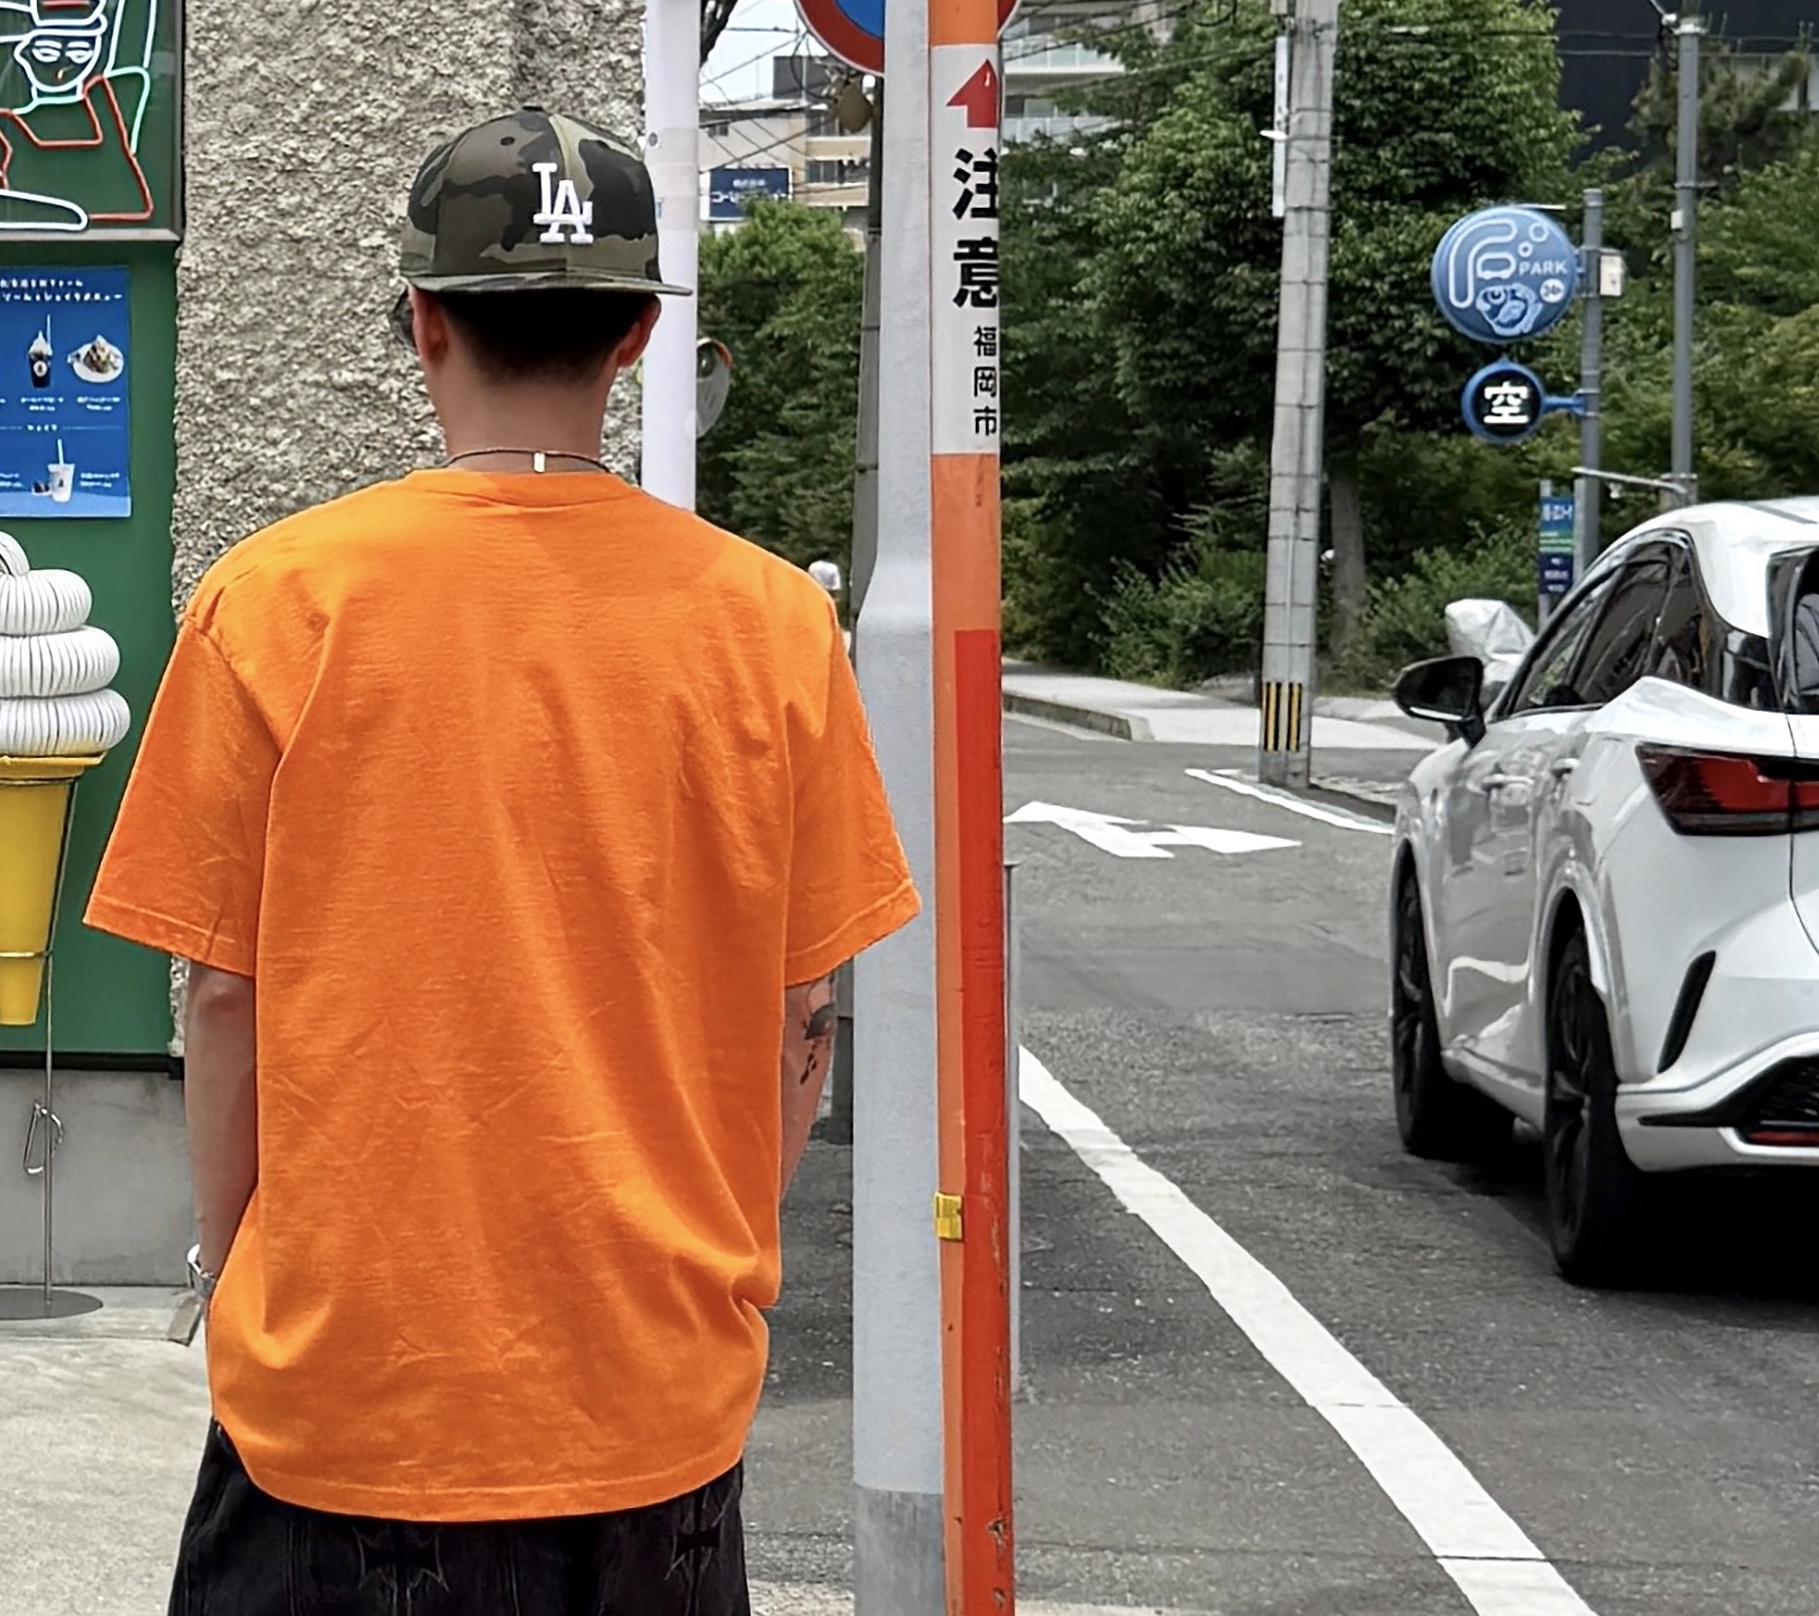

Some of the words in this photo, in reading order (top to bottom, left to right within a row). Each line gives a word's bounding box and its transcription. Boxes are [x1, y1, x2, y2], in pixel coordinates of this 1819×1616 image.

[533, 162, 594, 244] LA
[952, 147, 998, 308] 注意
[1518, 260, 1568, 276] PARK
[973, 325, 998, 437] 福岡市
[1484, 380, 1529, 425] 空
